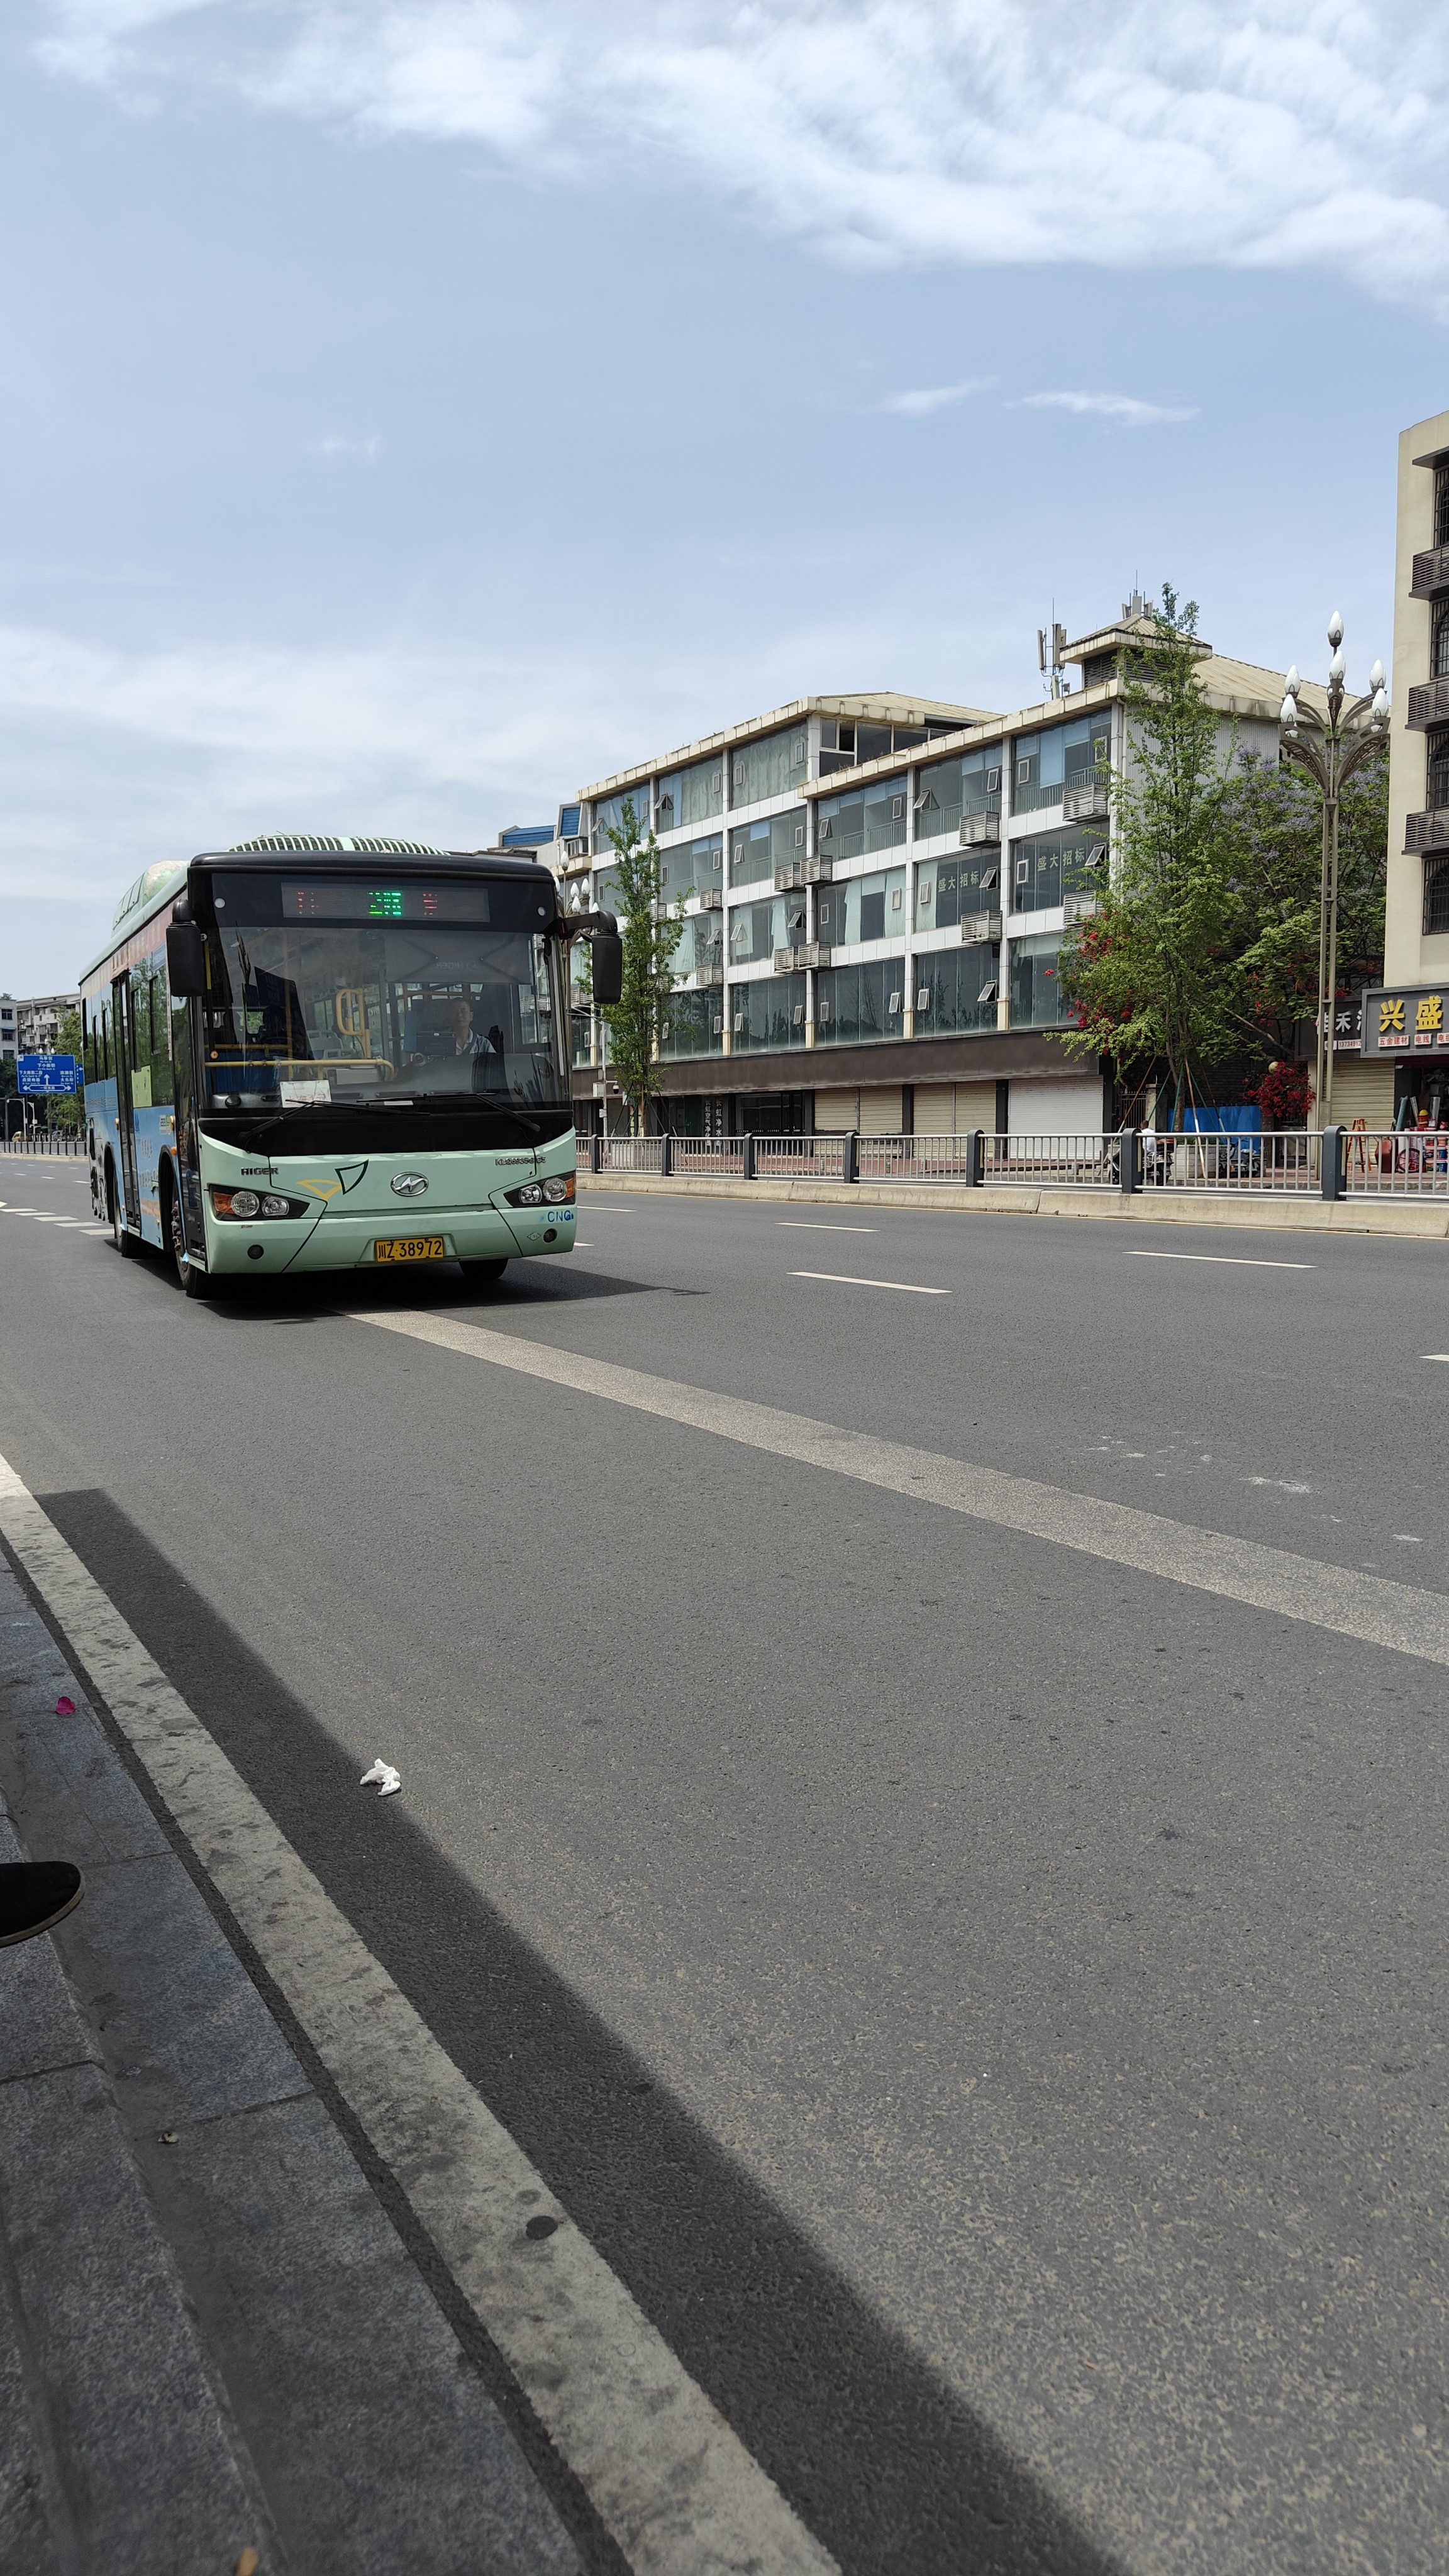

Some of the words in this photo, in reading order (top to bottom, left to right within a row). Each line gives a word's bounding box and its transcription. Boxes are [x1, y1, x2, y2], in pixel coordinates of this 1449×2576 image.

[1037, 848, 1085, 872] 盛大招标
[938, 870, 980, 893] 盛大招标
[1379, 994, 1444, 1033] 兴盛
[1379, 1036, 1408, 1046] 五金建材
[1415, 1035, 1430, 1044] 电线
[241, 1167, 279, 1175] HIGER
